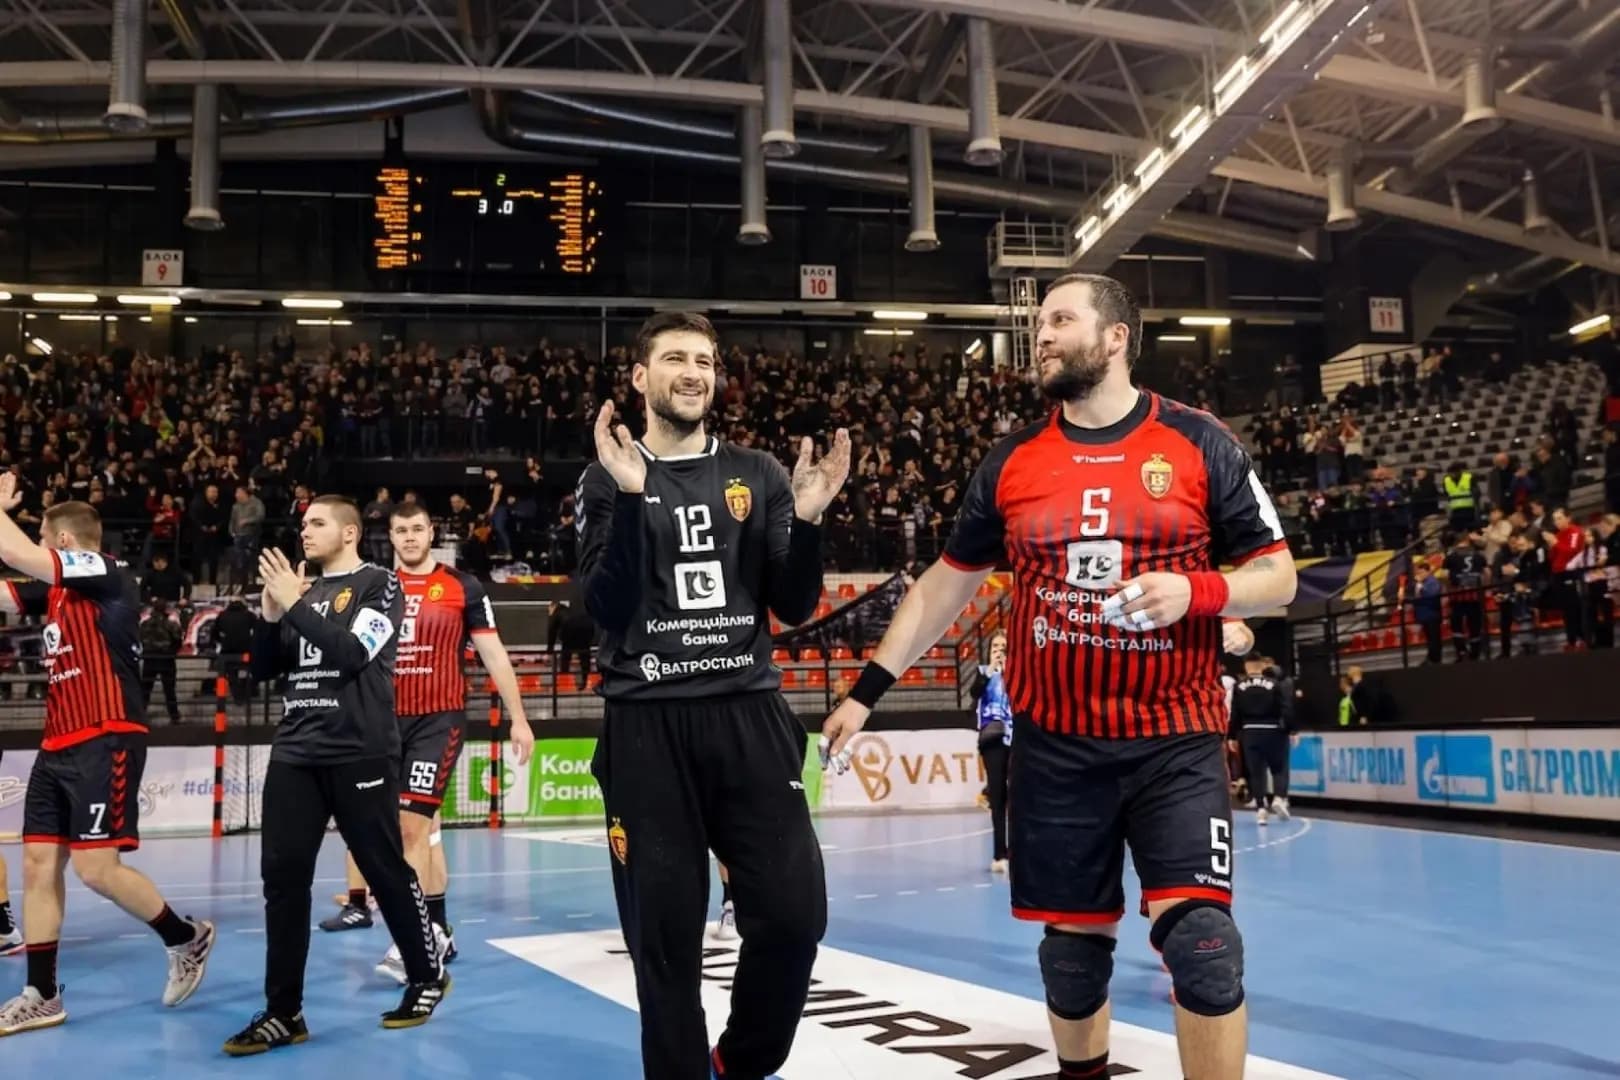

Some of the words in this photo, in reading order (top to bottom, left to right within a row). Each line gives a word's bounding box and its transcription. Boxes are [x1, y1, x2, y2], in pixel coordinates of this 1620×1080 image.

[158, 264, 168, 280] 9
[811, 279, 828, 296] 10
[1080, 488, 1111, 536] 5
[674, 504, 715, 552] 12
[1035, 586, 1111, 606] Комерц
[646, 613, 755, 634] Комерцијална
[681, 633, 729, 646] банка
[1048, 628, 1174, 651] ВАТРОСТАЛНА
[409, 761, 437, 788] 55
[1328, 747, 1407, 785] GAZPROM
[1500, 749, 1620, 797] GAZPROM
[90, 803, 106, 834] 7
[1210, 817, 1230, 875] 5
